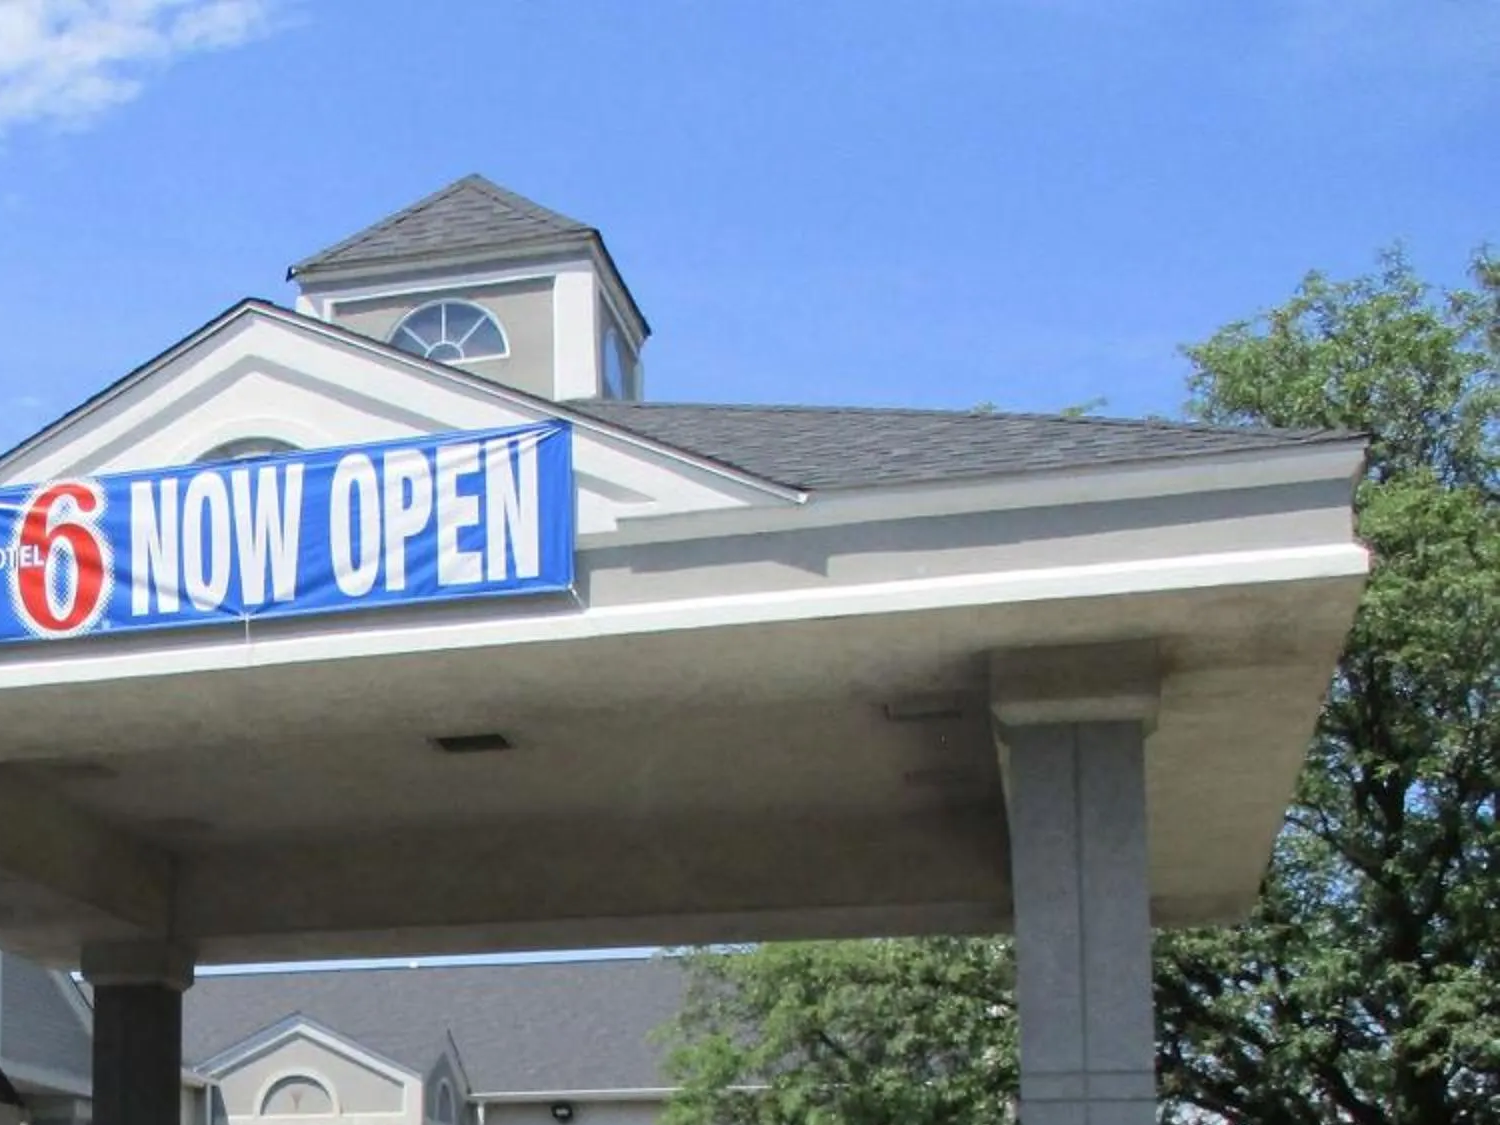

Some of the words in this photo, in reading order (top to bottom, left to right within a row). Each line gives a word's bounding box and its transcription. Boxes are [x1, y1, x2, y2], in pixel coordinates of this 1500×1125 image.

[17, 482, 105, 632] 6
[130, 463, 305, 617] NOW
[328, 436, 541, 597] OPEN
